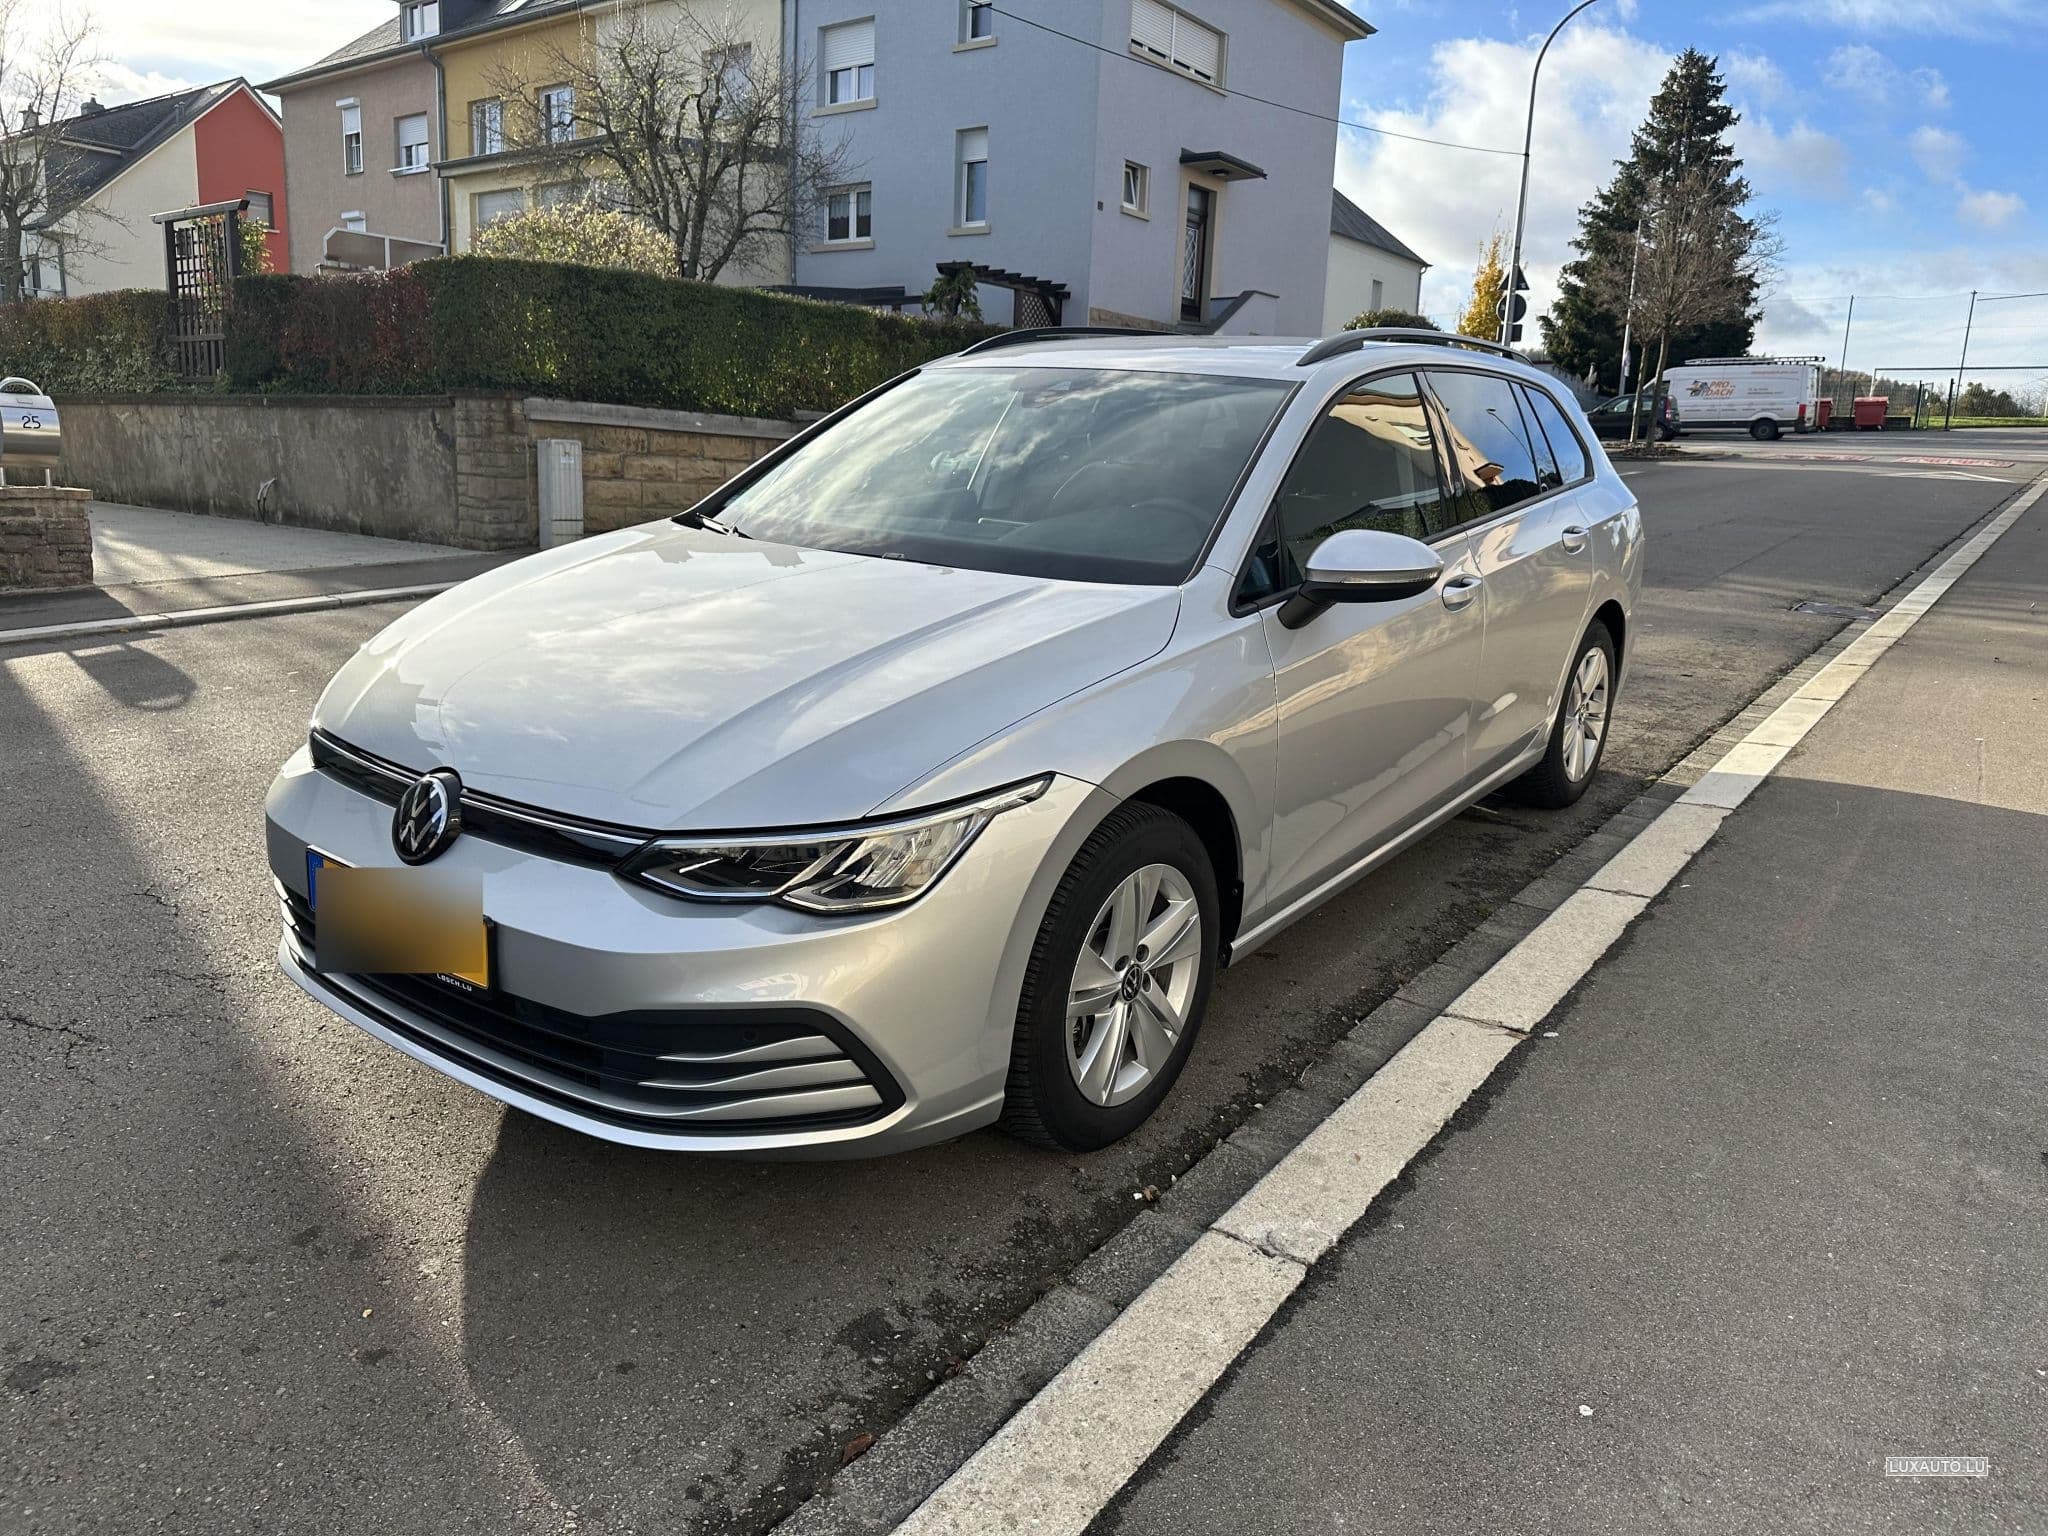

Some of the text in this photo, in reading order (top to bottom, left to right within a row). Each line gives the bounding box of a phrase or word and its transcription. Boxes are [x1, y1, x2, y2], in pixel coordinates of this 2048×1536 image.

[1709, 381, 1730, 389] PRO
[1706, 389, 1734, 397] DACH
[22, 415, 41, 429] 25
